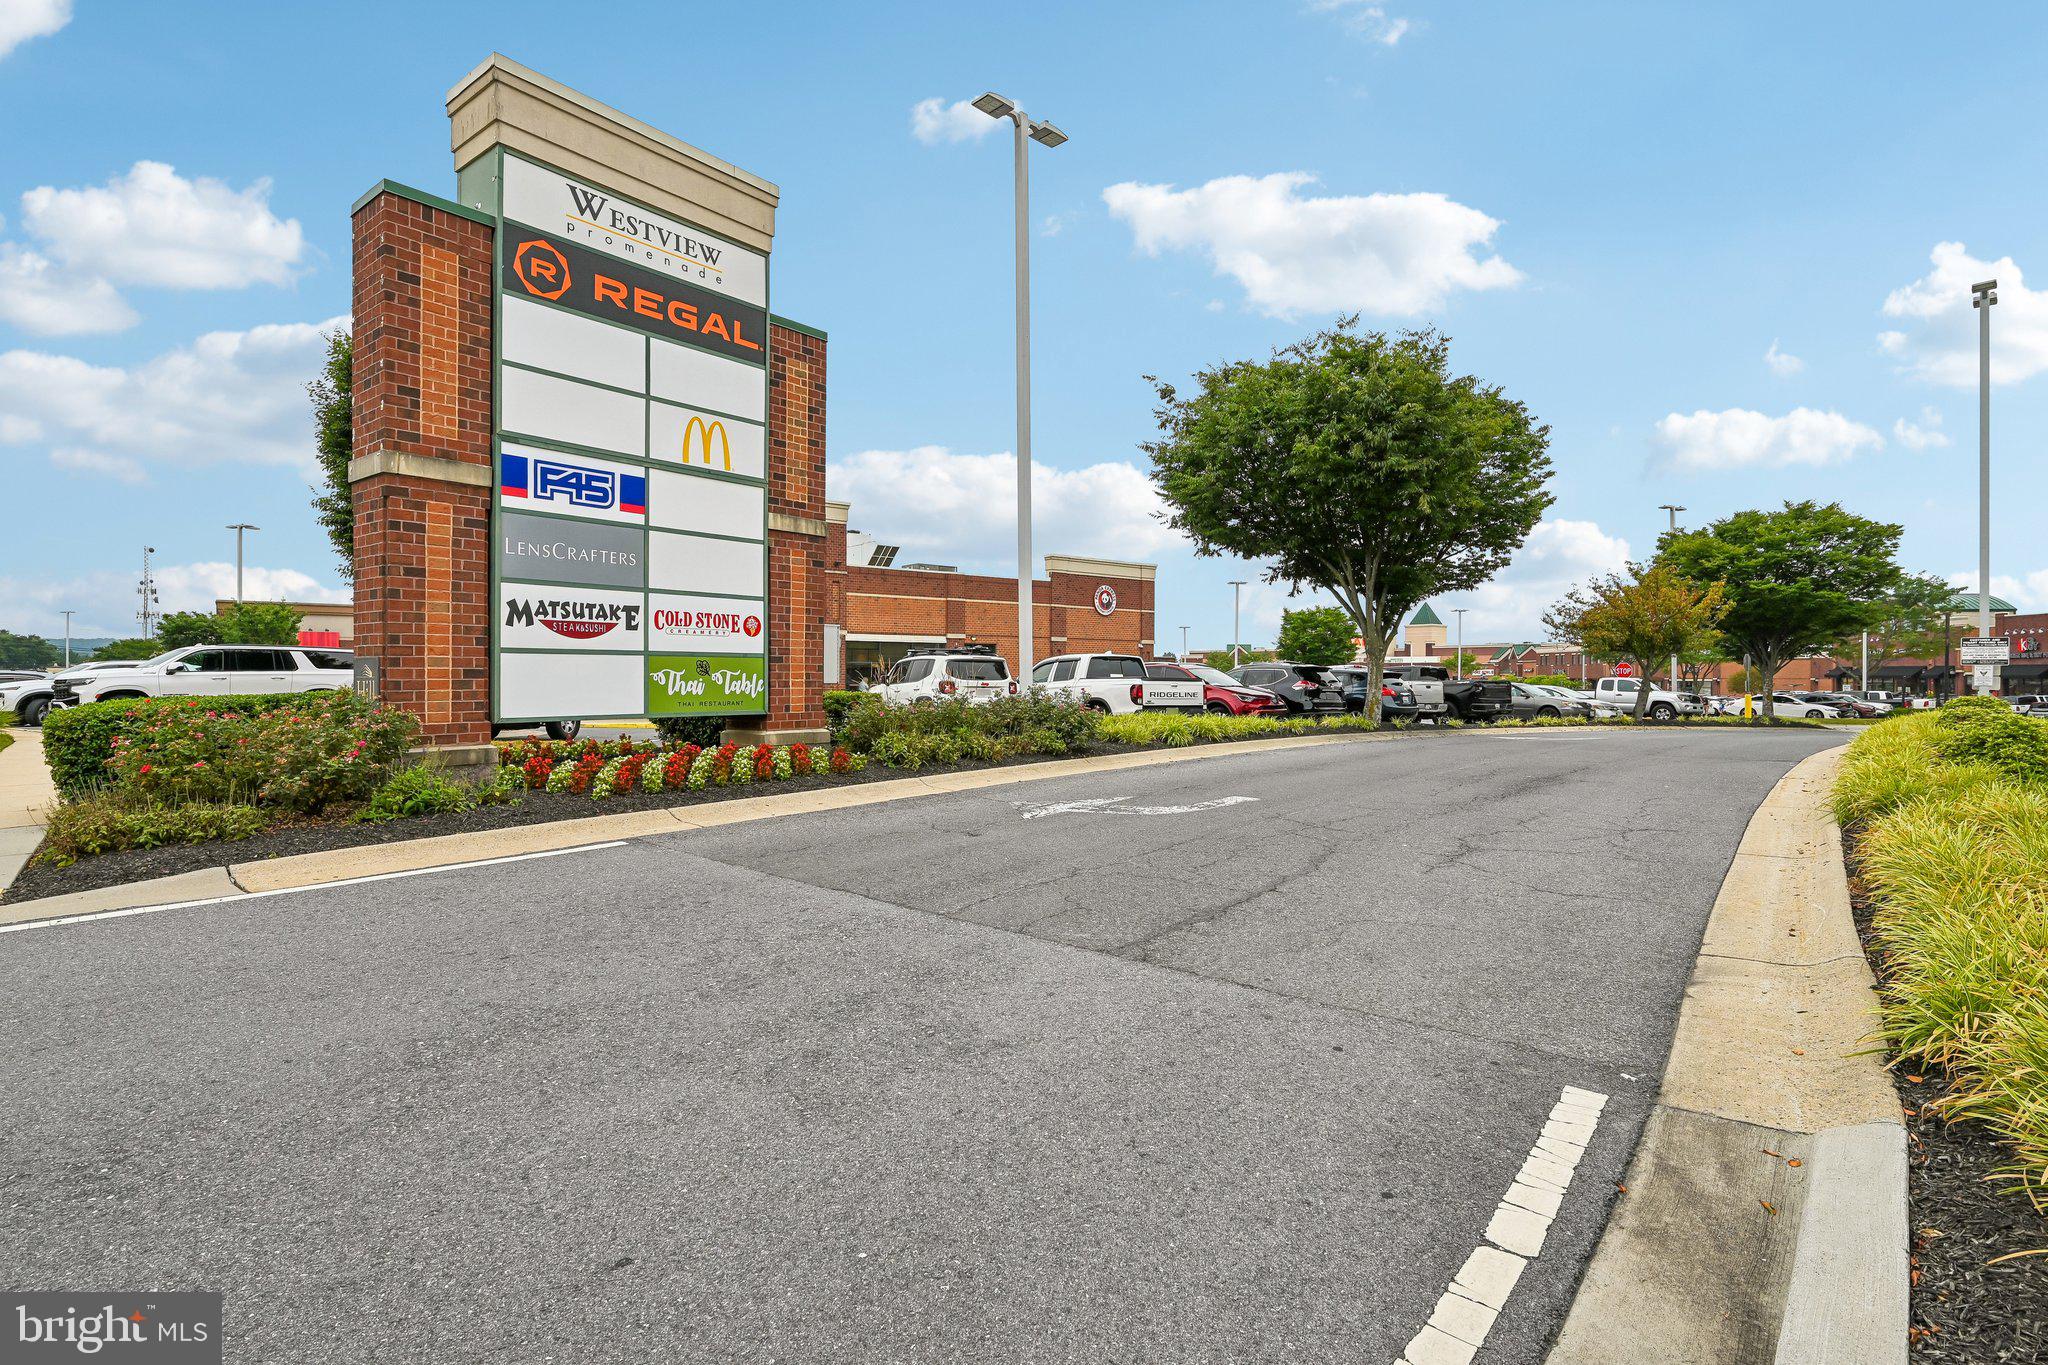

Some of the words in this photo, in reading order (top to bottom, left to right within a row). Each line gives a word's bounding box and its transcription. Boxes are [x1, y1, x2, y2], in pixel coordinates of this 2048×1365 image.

[566, 221, 723, 284] promenade
[594, 273, 759, 351] REGAL
[536, 461, 614, 508] F45
[505, 598, 641, 631] MATSUTAKE
[654, 609, 693, 631] COLD
[695, 611, 741, 634] STONE
[669, 628, 727, 636] CREAMERY
[649, 668, 706, 696] Thai
[711, 669, 765, 700] Table
[1616, 667, 1631, 675] STOP
